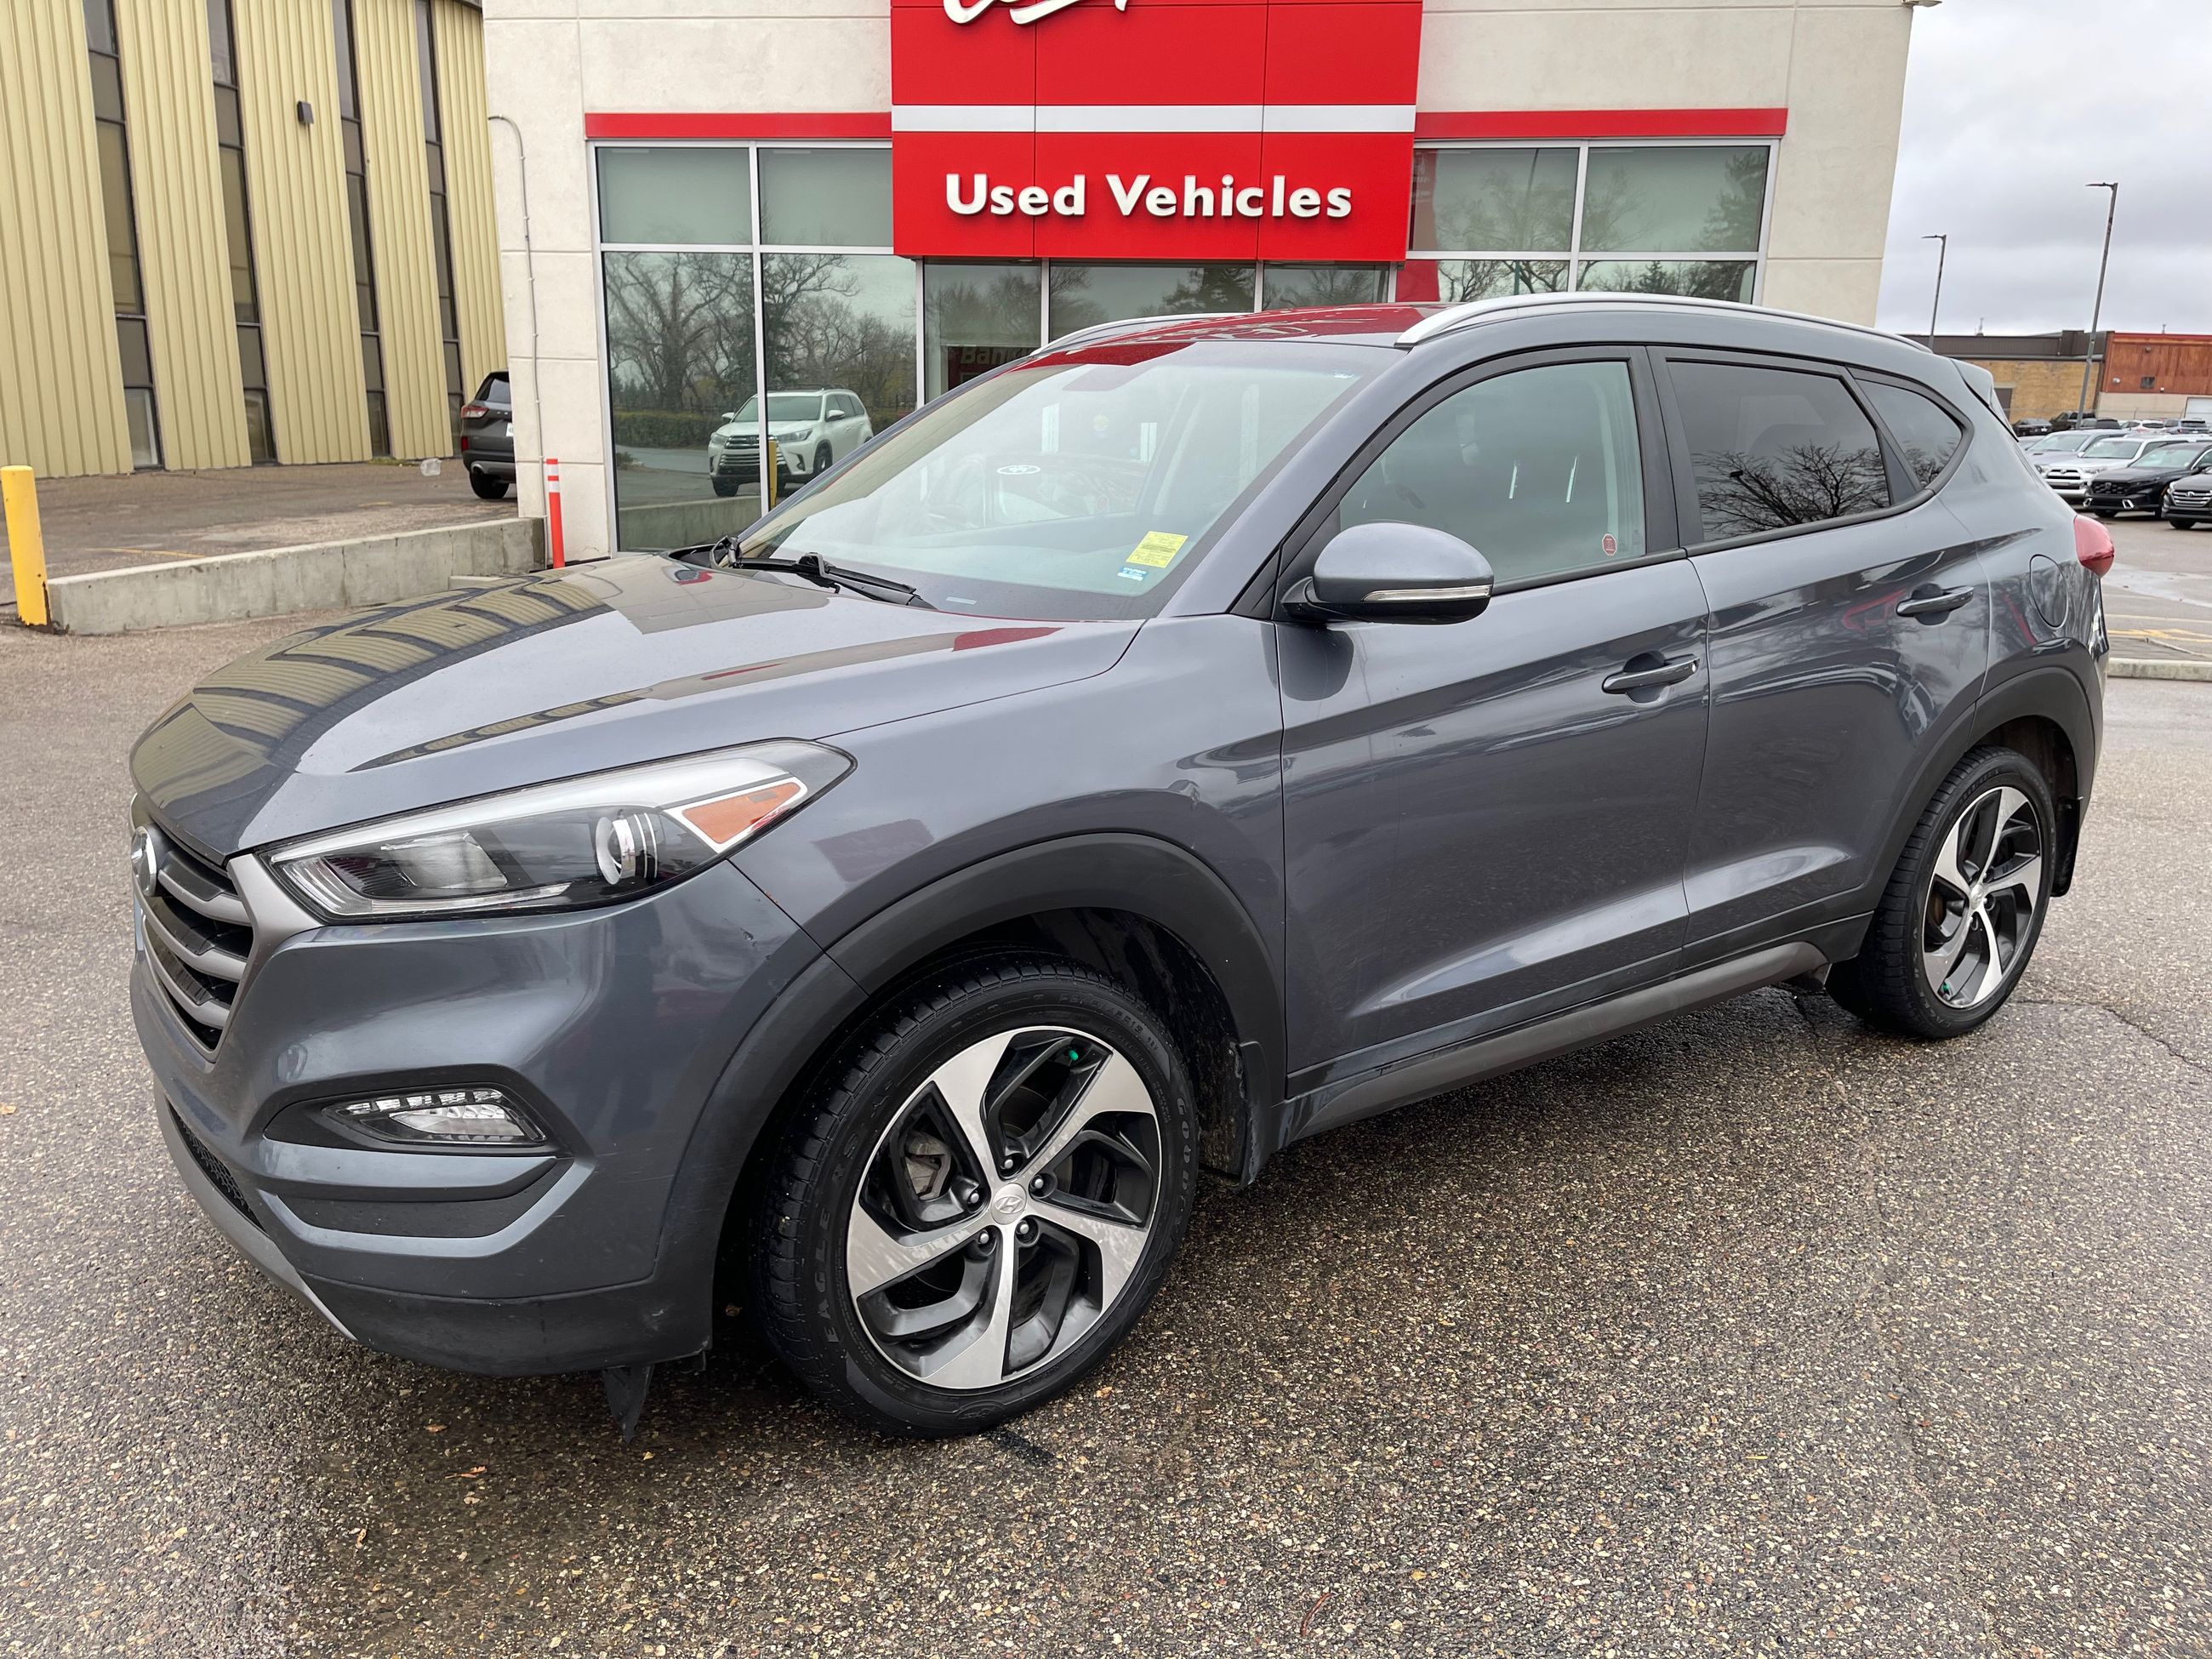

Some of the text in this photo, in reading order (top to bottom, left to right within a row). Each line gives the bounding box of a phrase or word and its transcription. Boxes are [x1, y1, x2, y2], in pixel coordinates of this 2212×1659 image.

[946, 174, 1353, 218] Used Vehicles
[814, 1209, 840, 1348] EAGLE
